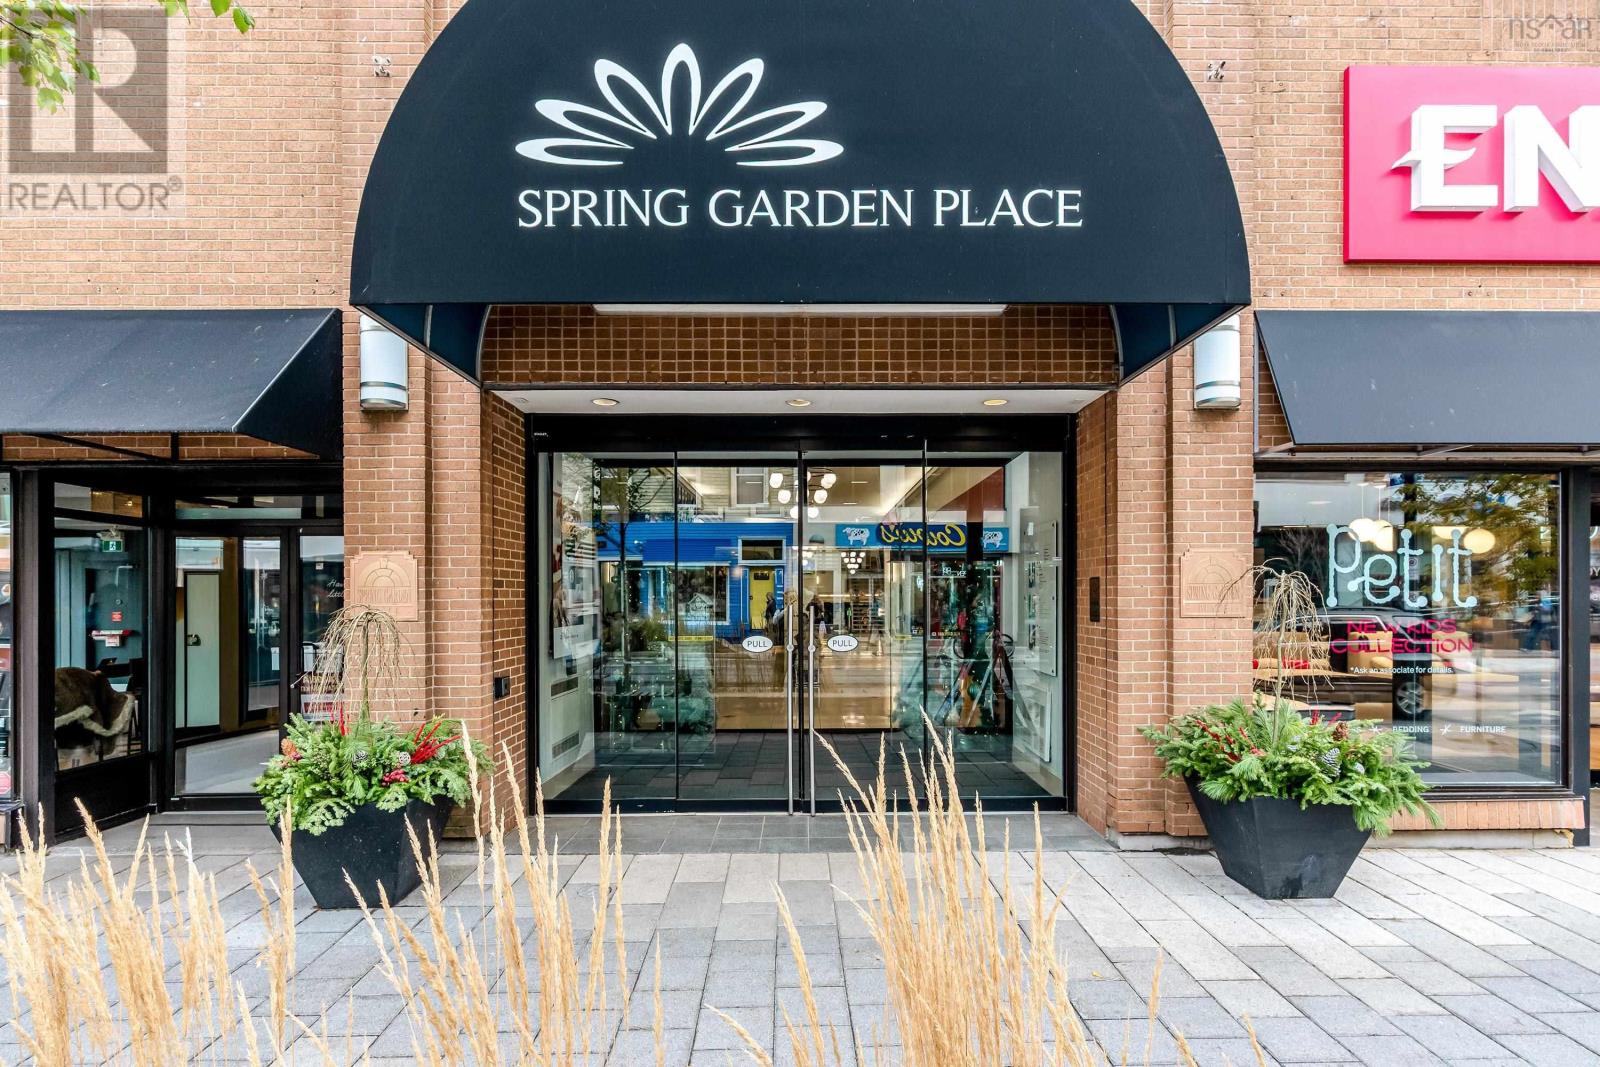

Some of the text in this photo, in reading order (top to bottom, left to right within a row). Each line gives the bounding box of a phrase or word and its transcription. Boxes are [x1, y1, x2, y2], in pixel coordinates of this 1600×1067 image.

[517, 188, 1084, 228] SPRING GARDEN PLACE
[1346, 618, 1457, 634] NEW KIDS
[747, 640, 768, 648] PULL
[832, 639, 853, 647] PULL
[1330, 638, 1473, 654] COLLECTION
[1380, 666, 1414, 674] associate
[1415, 666, 1426, 674] for
[1459, 725, 1507, 733] FURNITURE
